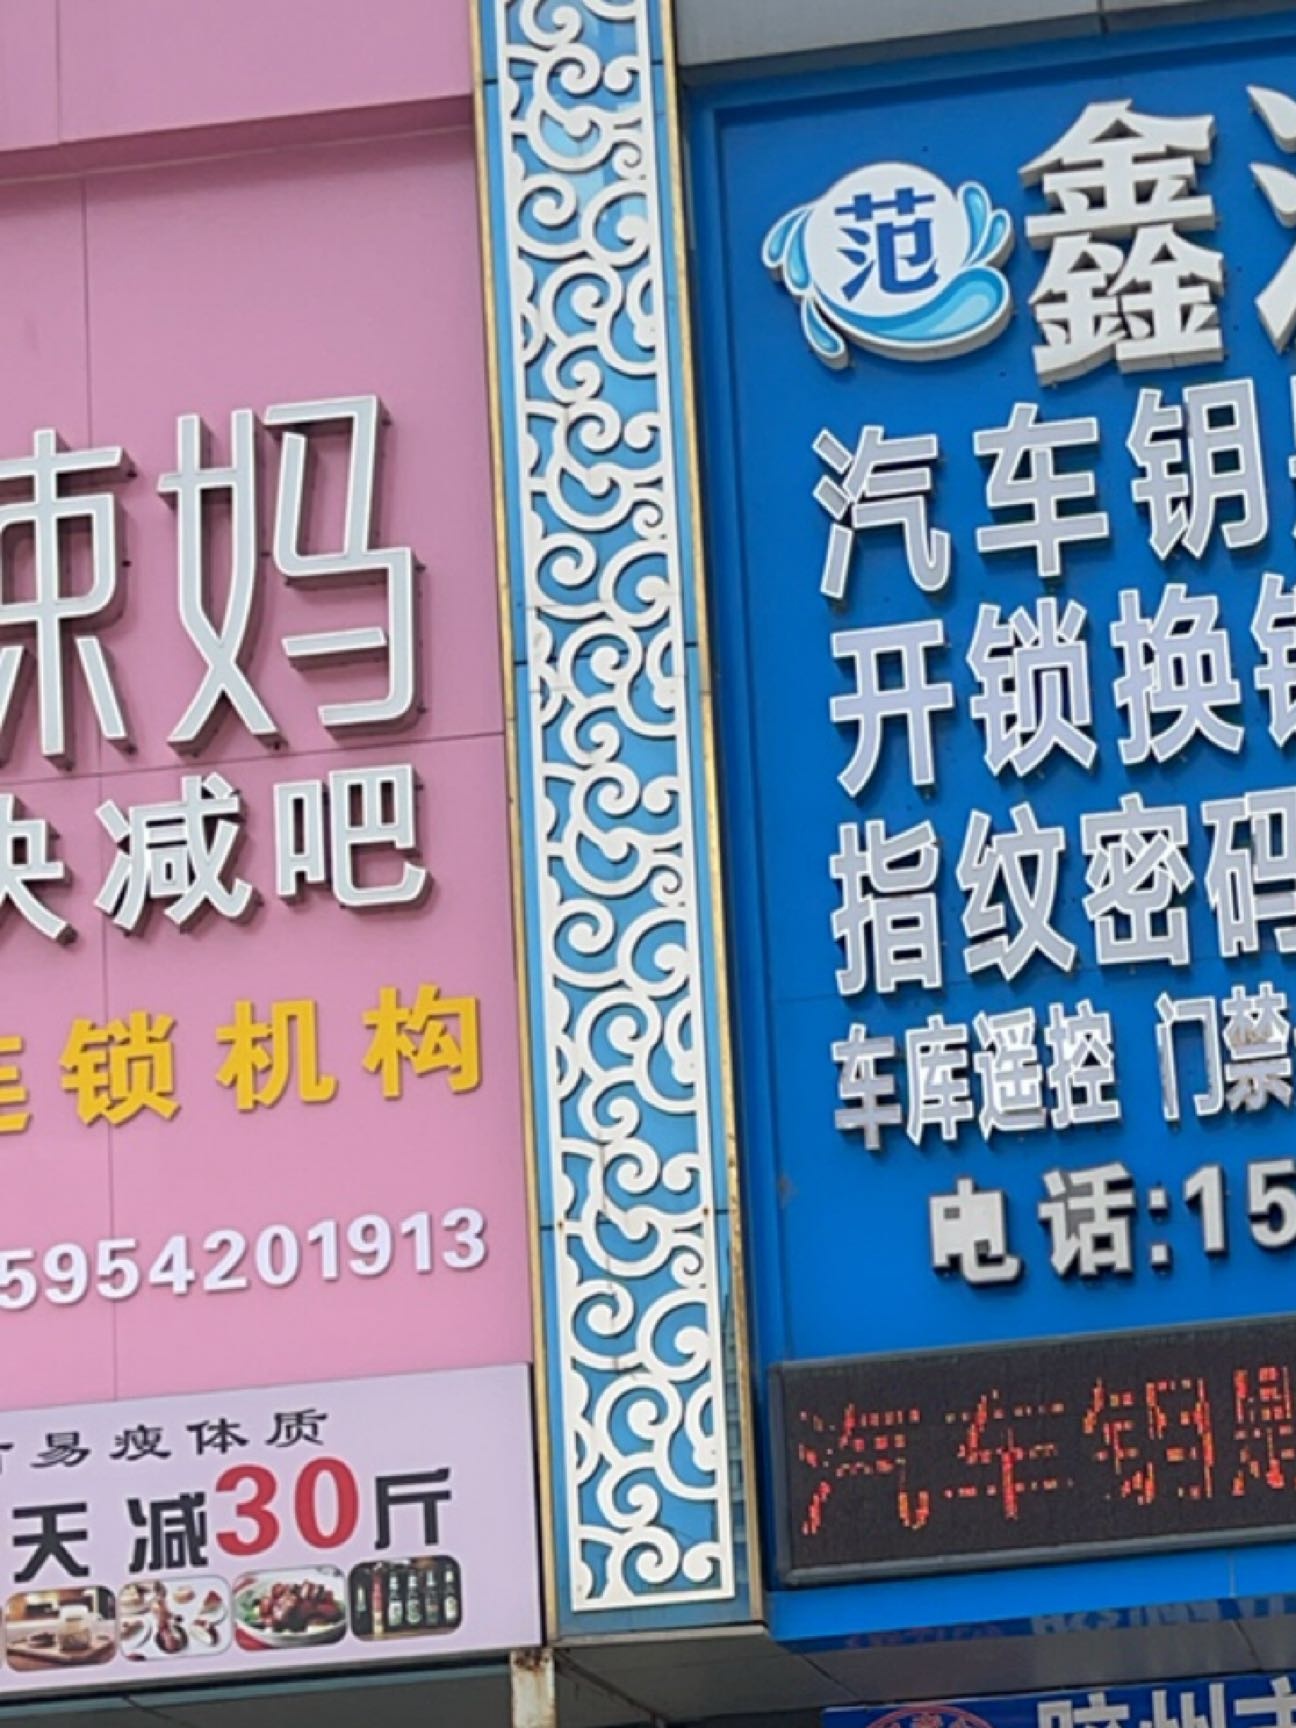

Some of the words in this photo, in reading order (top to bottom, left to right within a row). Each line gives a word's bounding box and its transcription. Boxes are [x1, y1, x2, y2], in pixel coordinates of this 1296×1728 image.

[834, 186, 938, 302] 范
[832, 1002, 1123, 1152] 车库遥控
[0, 1208, 487, 1312] 5954201913
[0, 1408, 328, 1476] 易瘦体质
